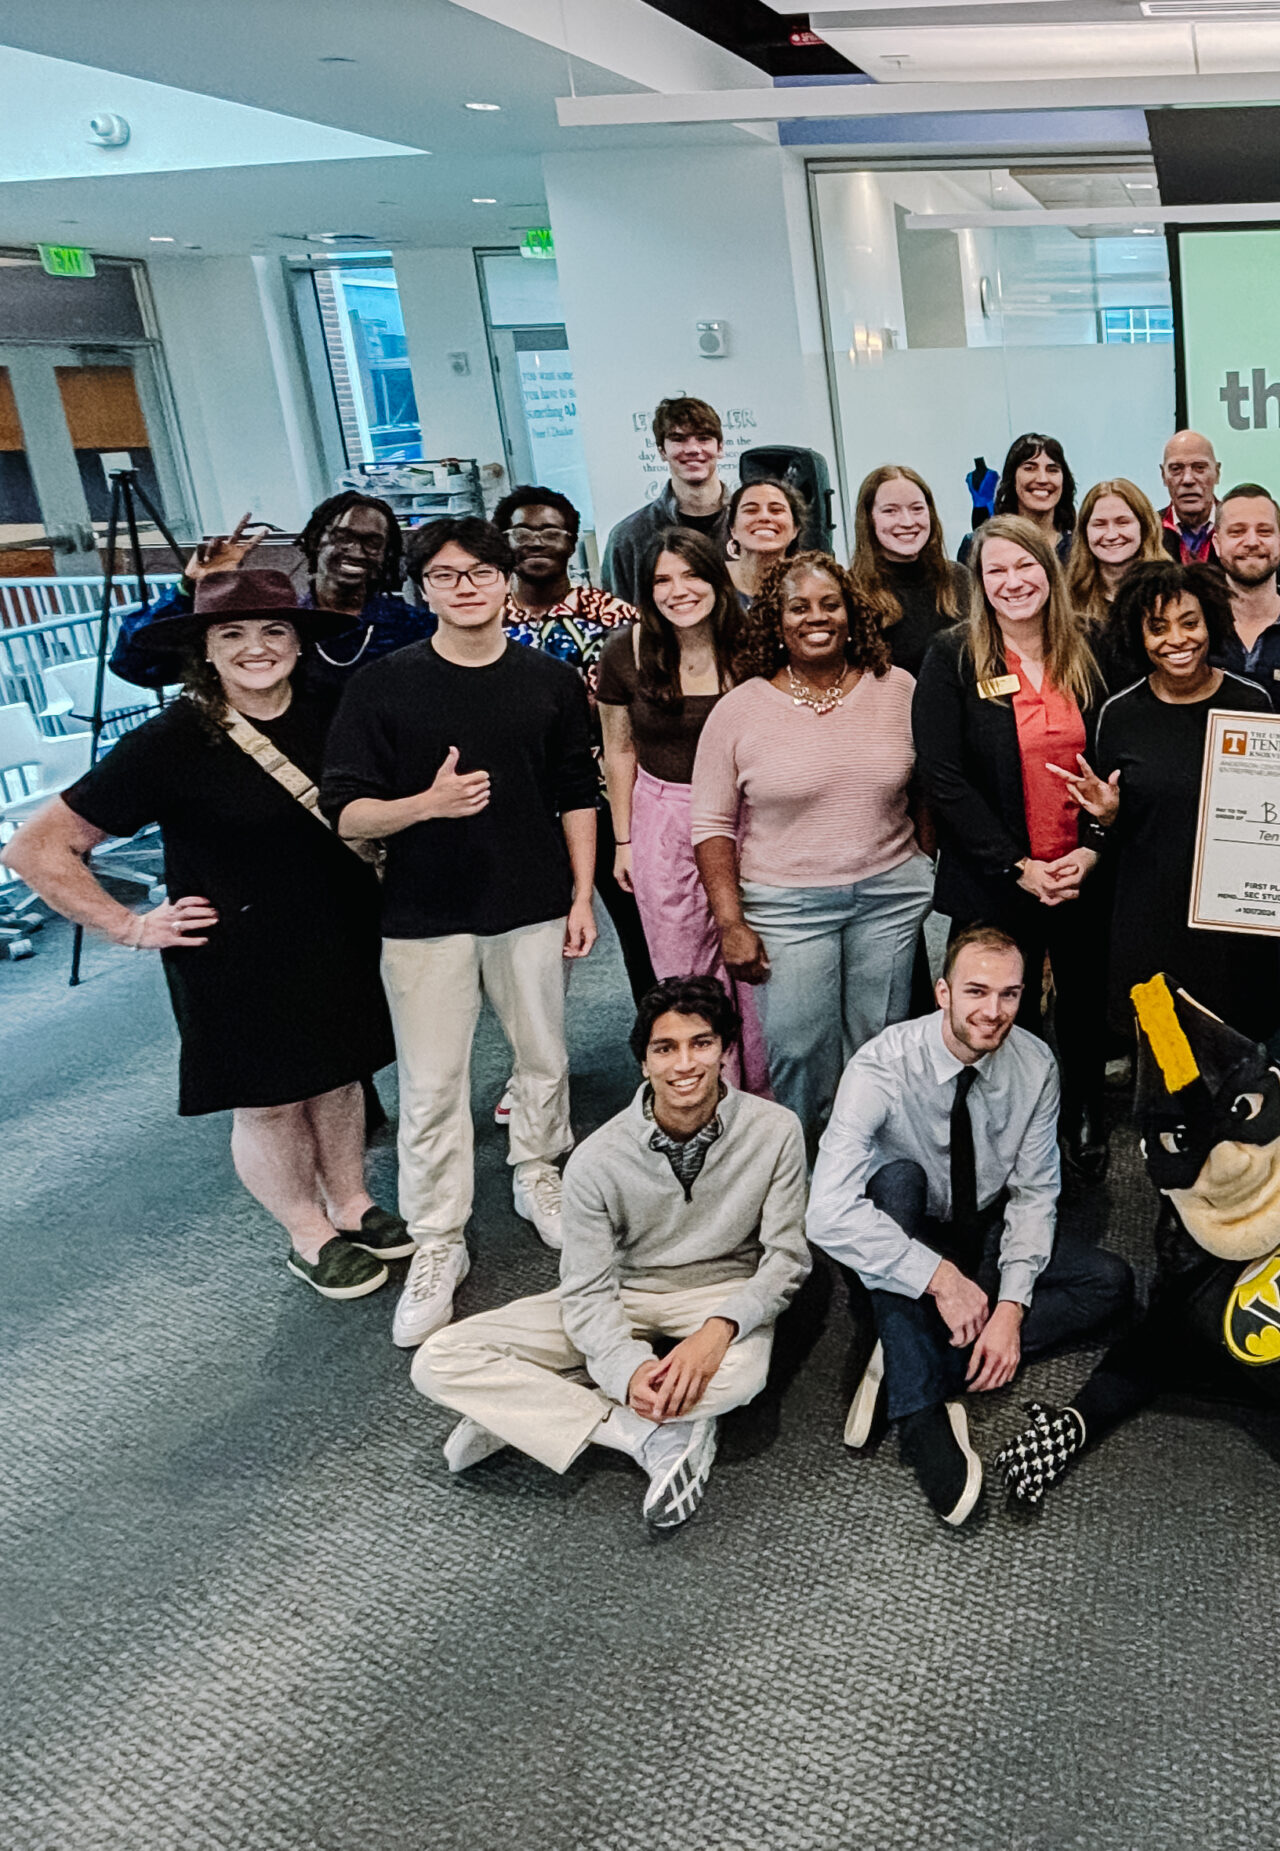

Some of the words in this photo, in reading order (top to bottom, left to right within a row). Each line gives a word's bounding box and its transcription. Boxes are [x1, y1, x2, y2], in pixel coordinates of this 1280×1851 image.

[638, 451, 656, 463] day
[643, 463, 669, 472] throu
[1250, 731, 1267, 739] THE
[1259, 830, 1279, 842] Ten
[1244, 881, 1268, 890] FIRST
[1244, 891, 1260, 899] SEC
